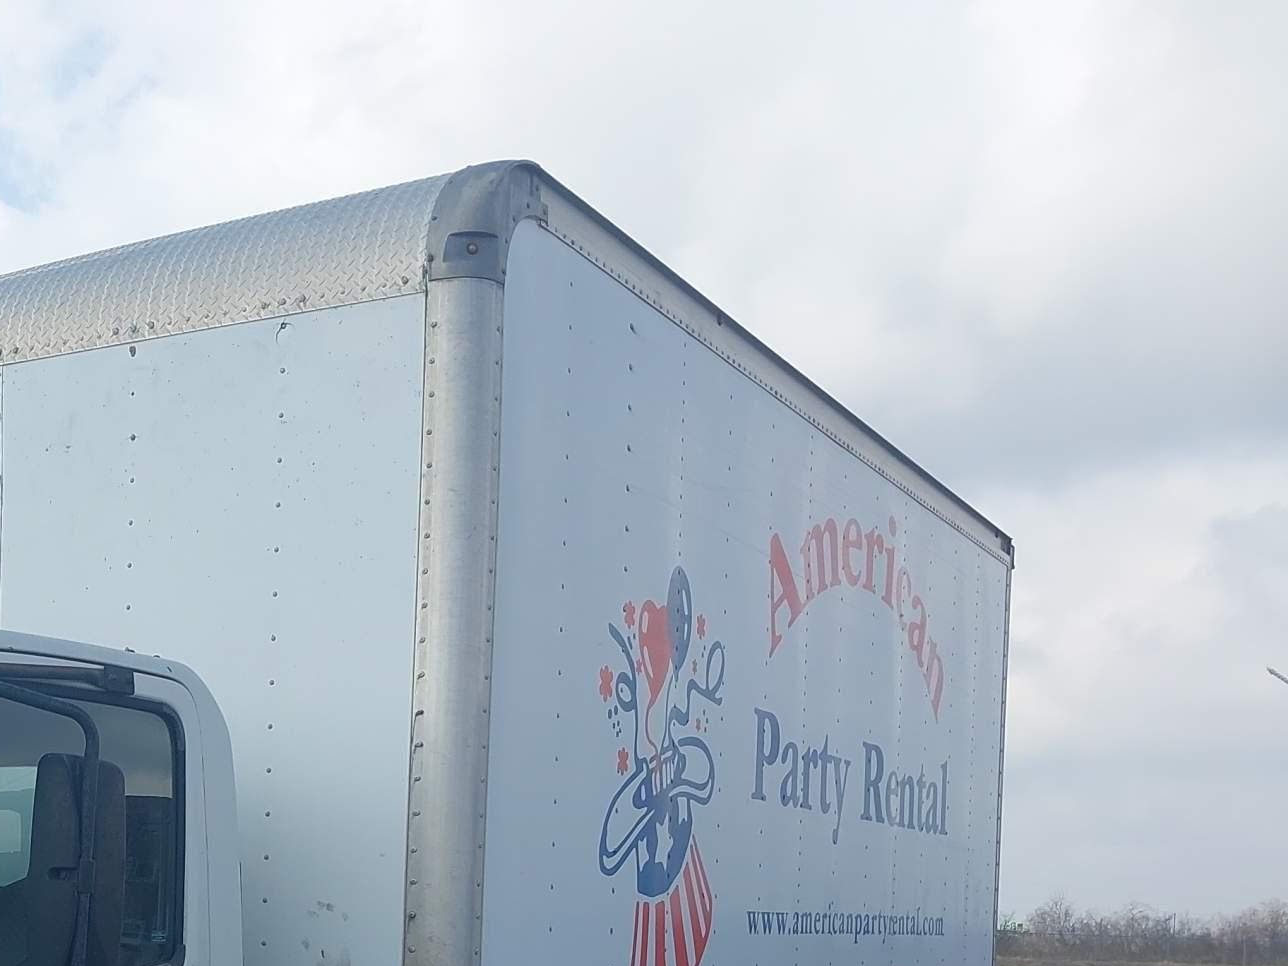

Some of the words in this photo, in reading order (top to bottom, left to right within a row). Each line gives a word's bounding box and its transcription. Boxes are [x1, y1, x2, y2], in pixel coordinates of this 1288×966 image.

[769, 515, 945, 724] American
[751, 706, 851, 845] Party
[860, 740, 948, 836] Rental
[746, 906, 945, 945] www.americanpartyrental.com
